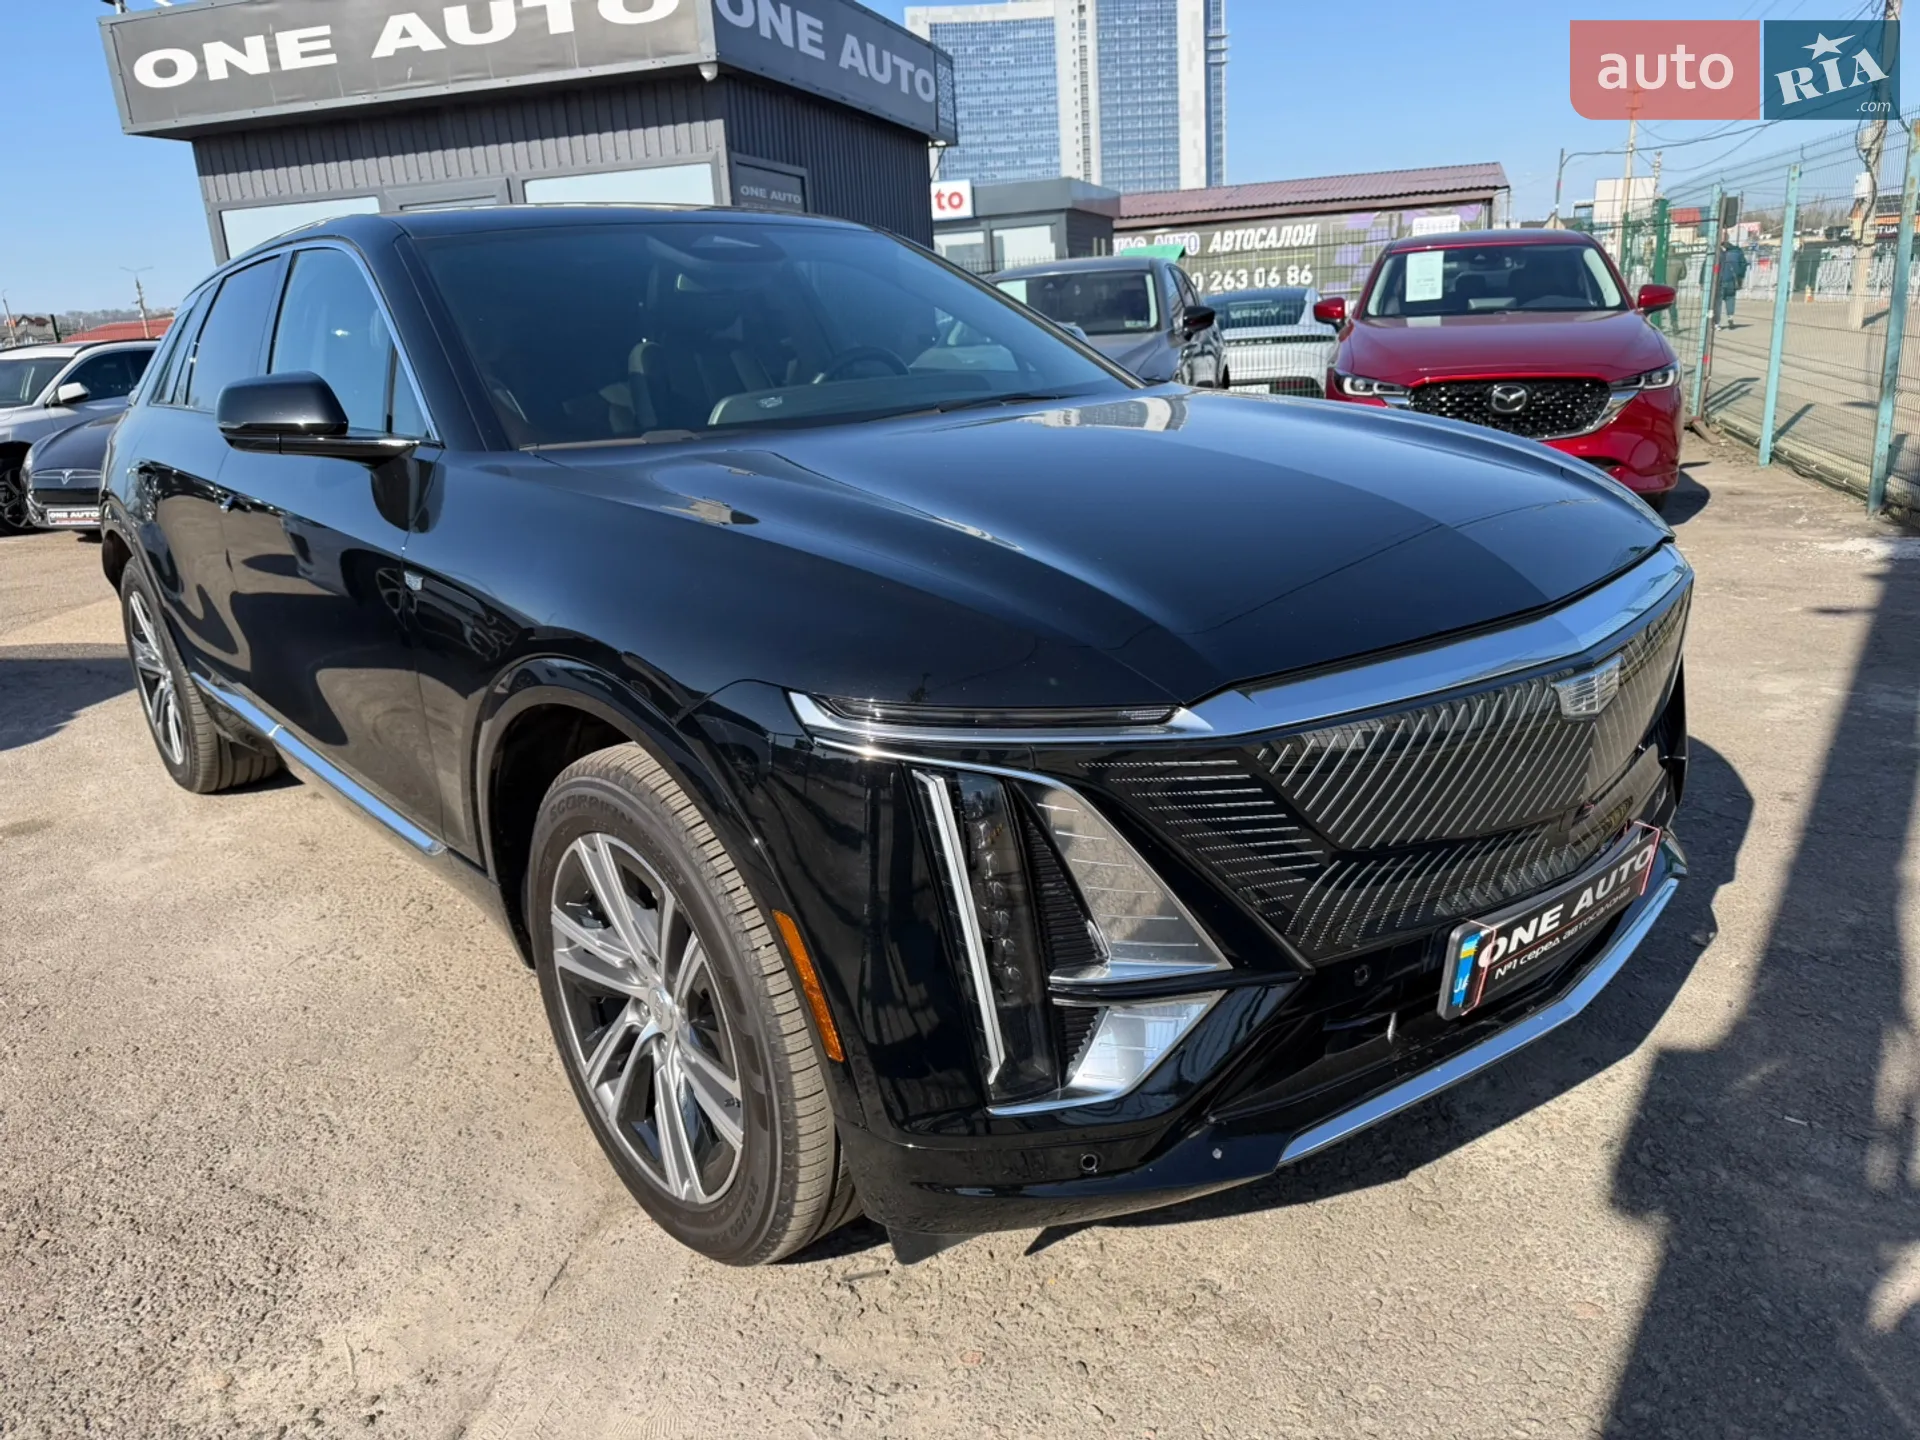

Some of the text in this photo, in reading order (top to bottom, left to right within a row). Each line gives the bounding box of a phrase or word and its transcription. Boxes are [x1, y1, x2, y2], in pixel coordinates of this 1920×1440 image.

[133, 0, 680, 88] ONE AUTO
[716, 0, 936, 102] ONE AUTO
[740, 185, 802, 204] ONE AUTO
[1207, 223, 1318, 253] АВТОСАЛОН
[1208, 271, 1249, 291] 263
[1254, 267, 1280, 288] 06
[1286, 264, 1313, 285] 86
[1477, 844, 1654, 968] ONE AUTO
